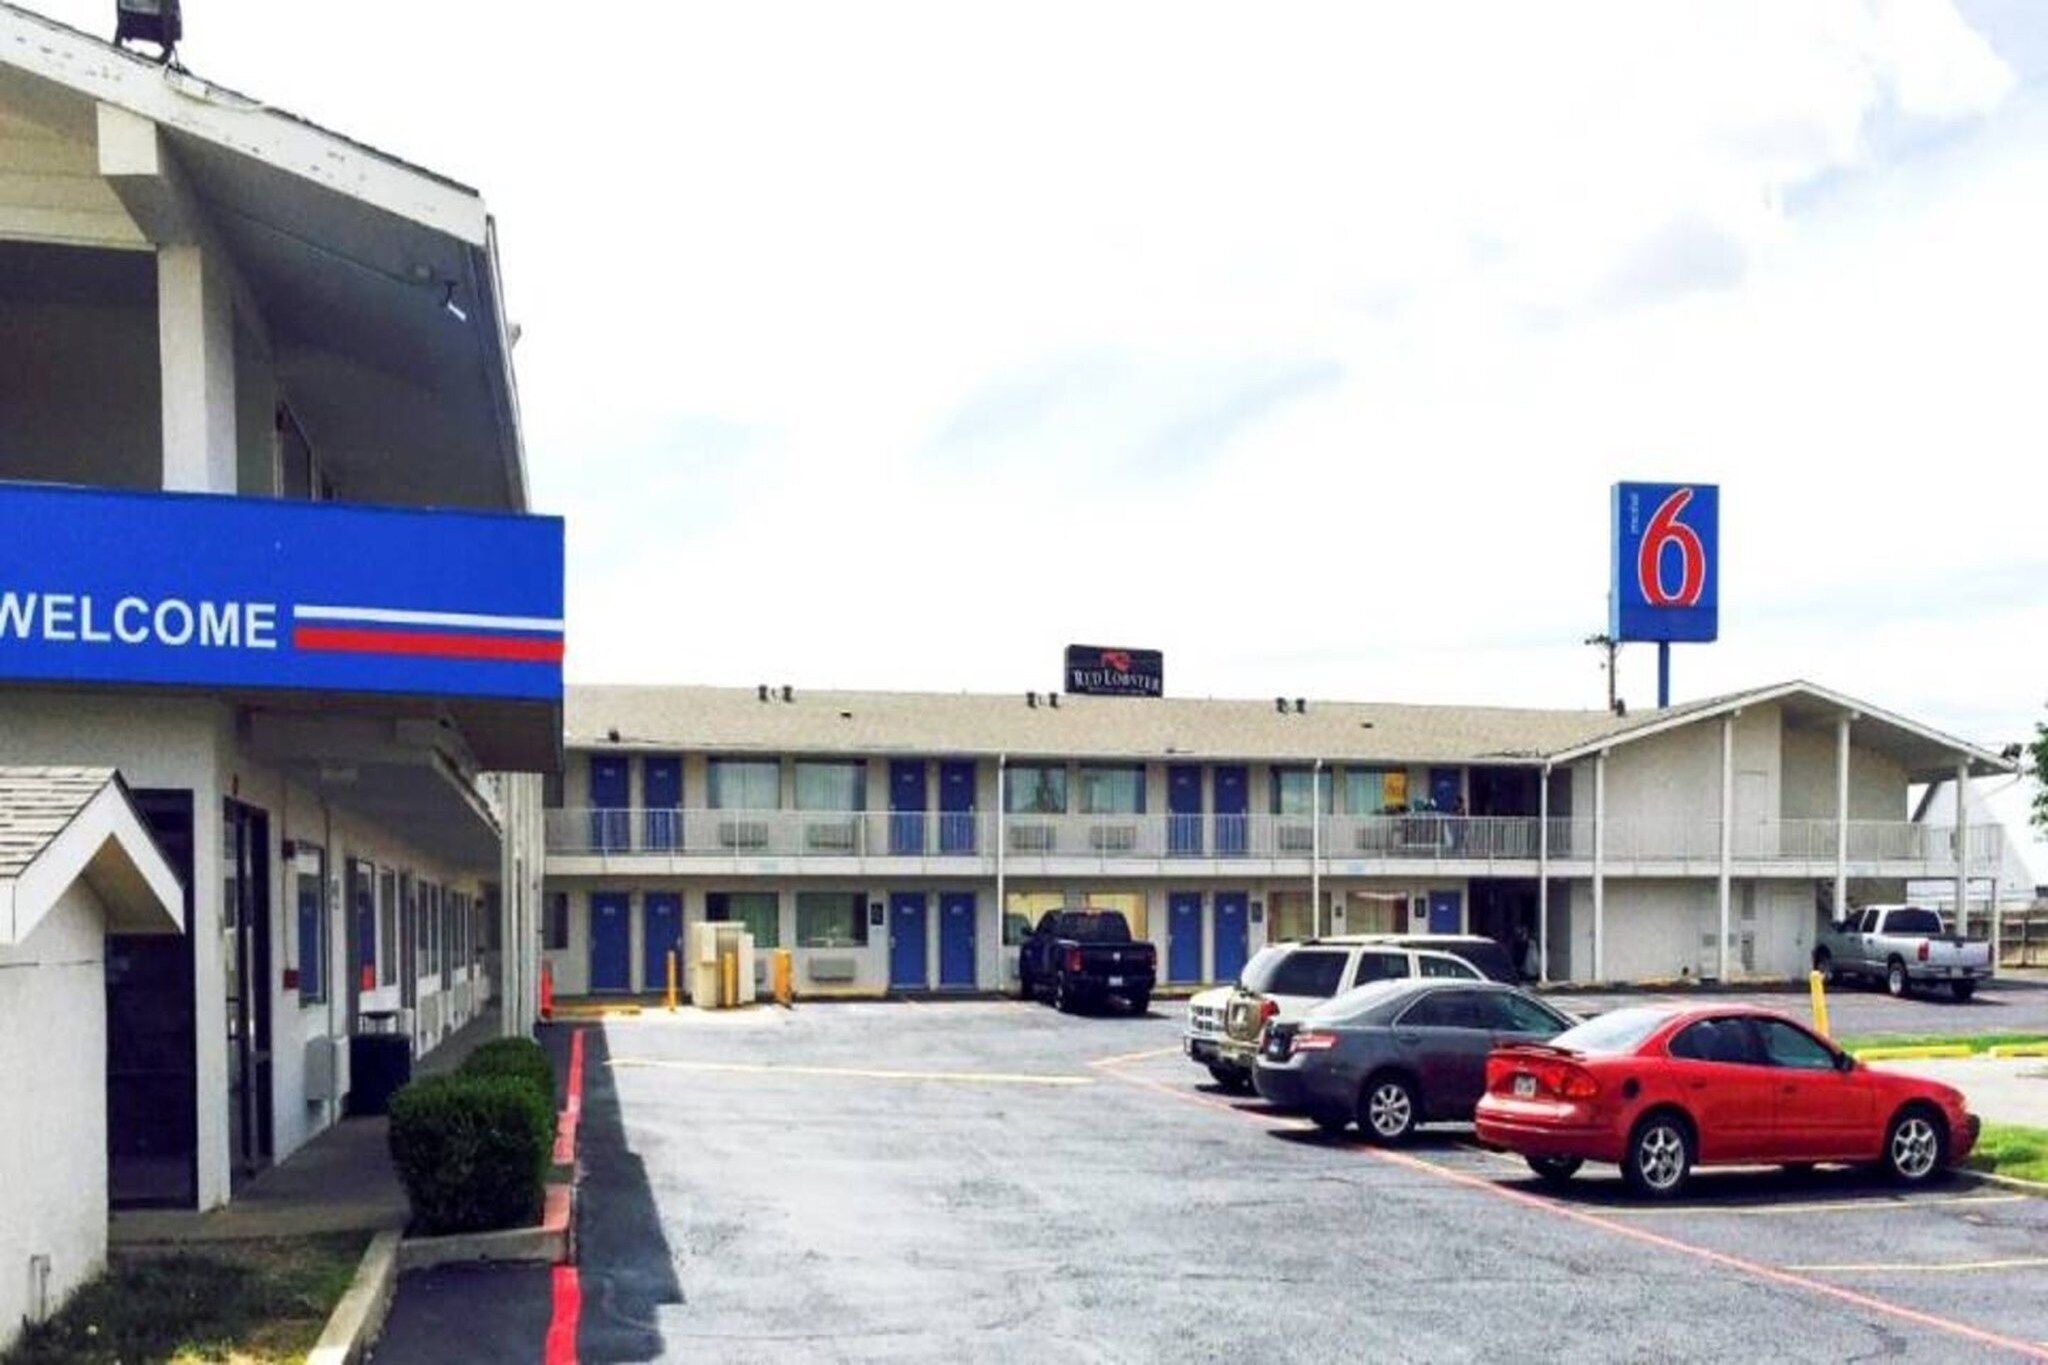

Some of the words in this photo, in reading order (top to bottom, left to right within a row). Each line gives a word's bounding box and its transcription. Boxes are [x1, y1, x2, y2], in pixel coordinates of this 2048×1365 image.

[1638, 488, 1705, 606] 6
[0, 592, 277, 648] WELCOME
[1073, 669, 1102, 687] RED
[1104, 668, 1160, 692] LOBSTER
